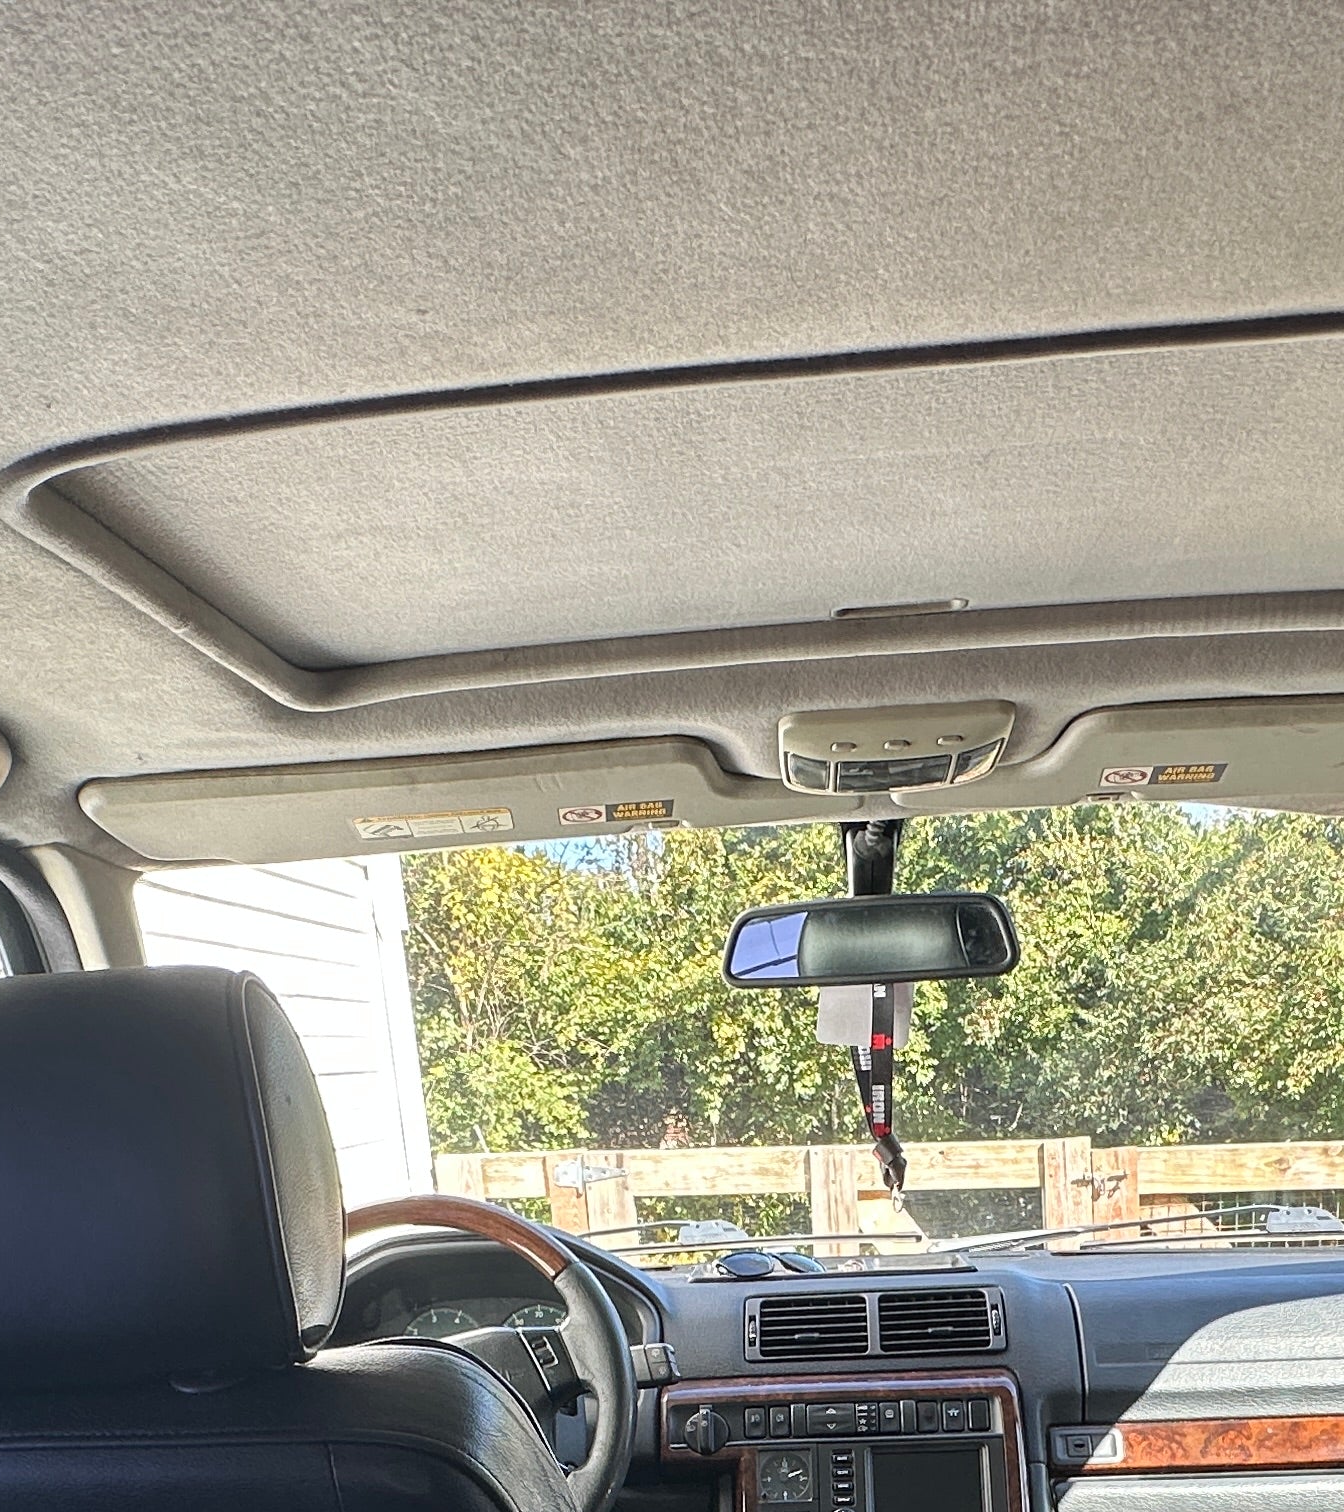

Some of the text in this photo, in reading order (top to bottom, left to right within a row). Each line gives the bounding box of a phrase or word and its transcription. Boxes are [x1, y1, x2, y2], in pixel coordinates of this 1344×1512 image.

[1164, 765, 1215, 774] AIR BAG
[1157, 772, 1216, 781] WARNING
[617, 804, 636, 812] AIR
[613, 808, 667, 818] WARNING
